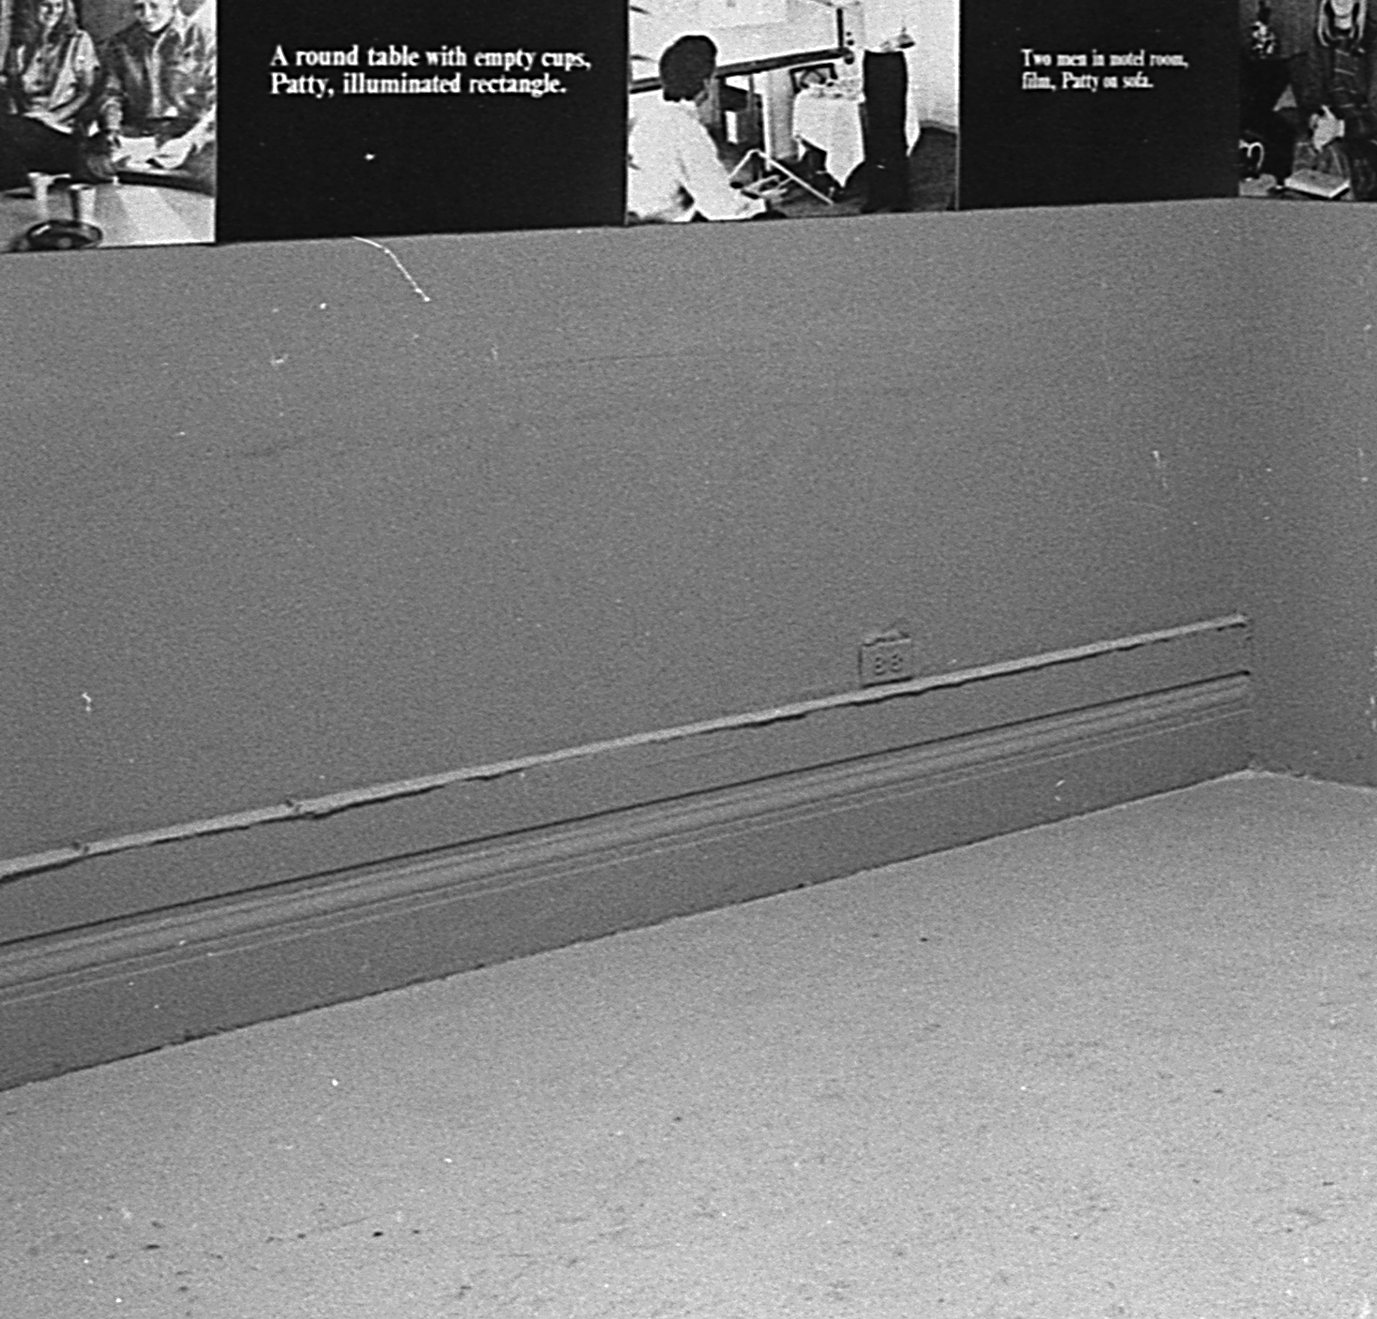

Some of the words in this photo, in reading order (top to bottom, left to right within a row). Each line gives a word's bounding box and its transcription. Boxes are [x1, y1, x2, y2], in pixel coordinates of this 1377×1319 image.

[269, 44, 289, 67] A
[295, 43, 359, 67] round
[367, 44, 421, 67] table
[424, 44, 468, 67] with
[473, 48, 537, 72] empty
[540, 51, 592, 74] cups,
[1020, 48, 1053, 67] Two
[1056, 54, 1088, 67] men
[1091, 48, 1106, 67] in
[1109, 48, 1146, 67] motel
[1149, 54, 1189, 68] room,
[270, 71, 335, 99] Patty,
[342, 71, 462, 95] illuminated
[468, 71, 568, 99] rectangle.
[1021, 71, 1057, 91] film,
[1061, 70, 1099, 93] Patty
[1102, 76, 1119, 89] on
[1122, 70, 1155, 89] sofa.
